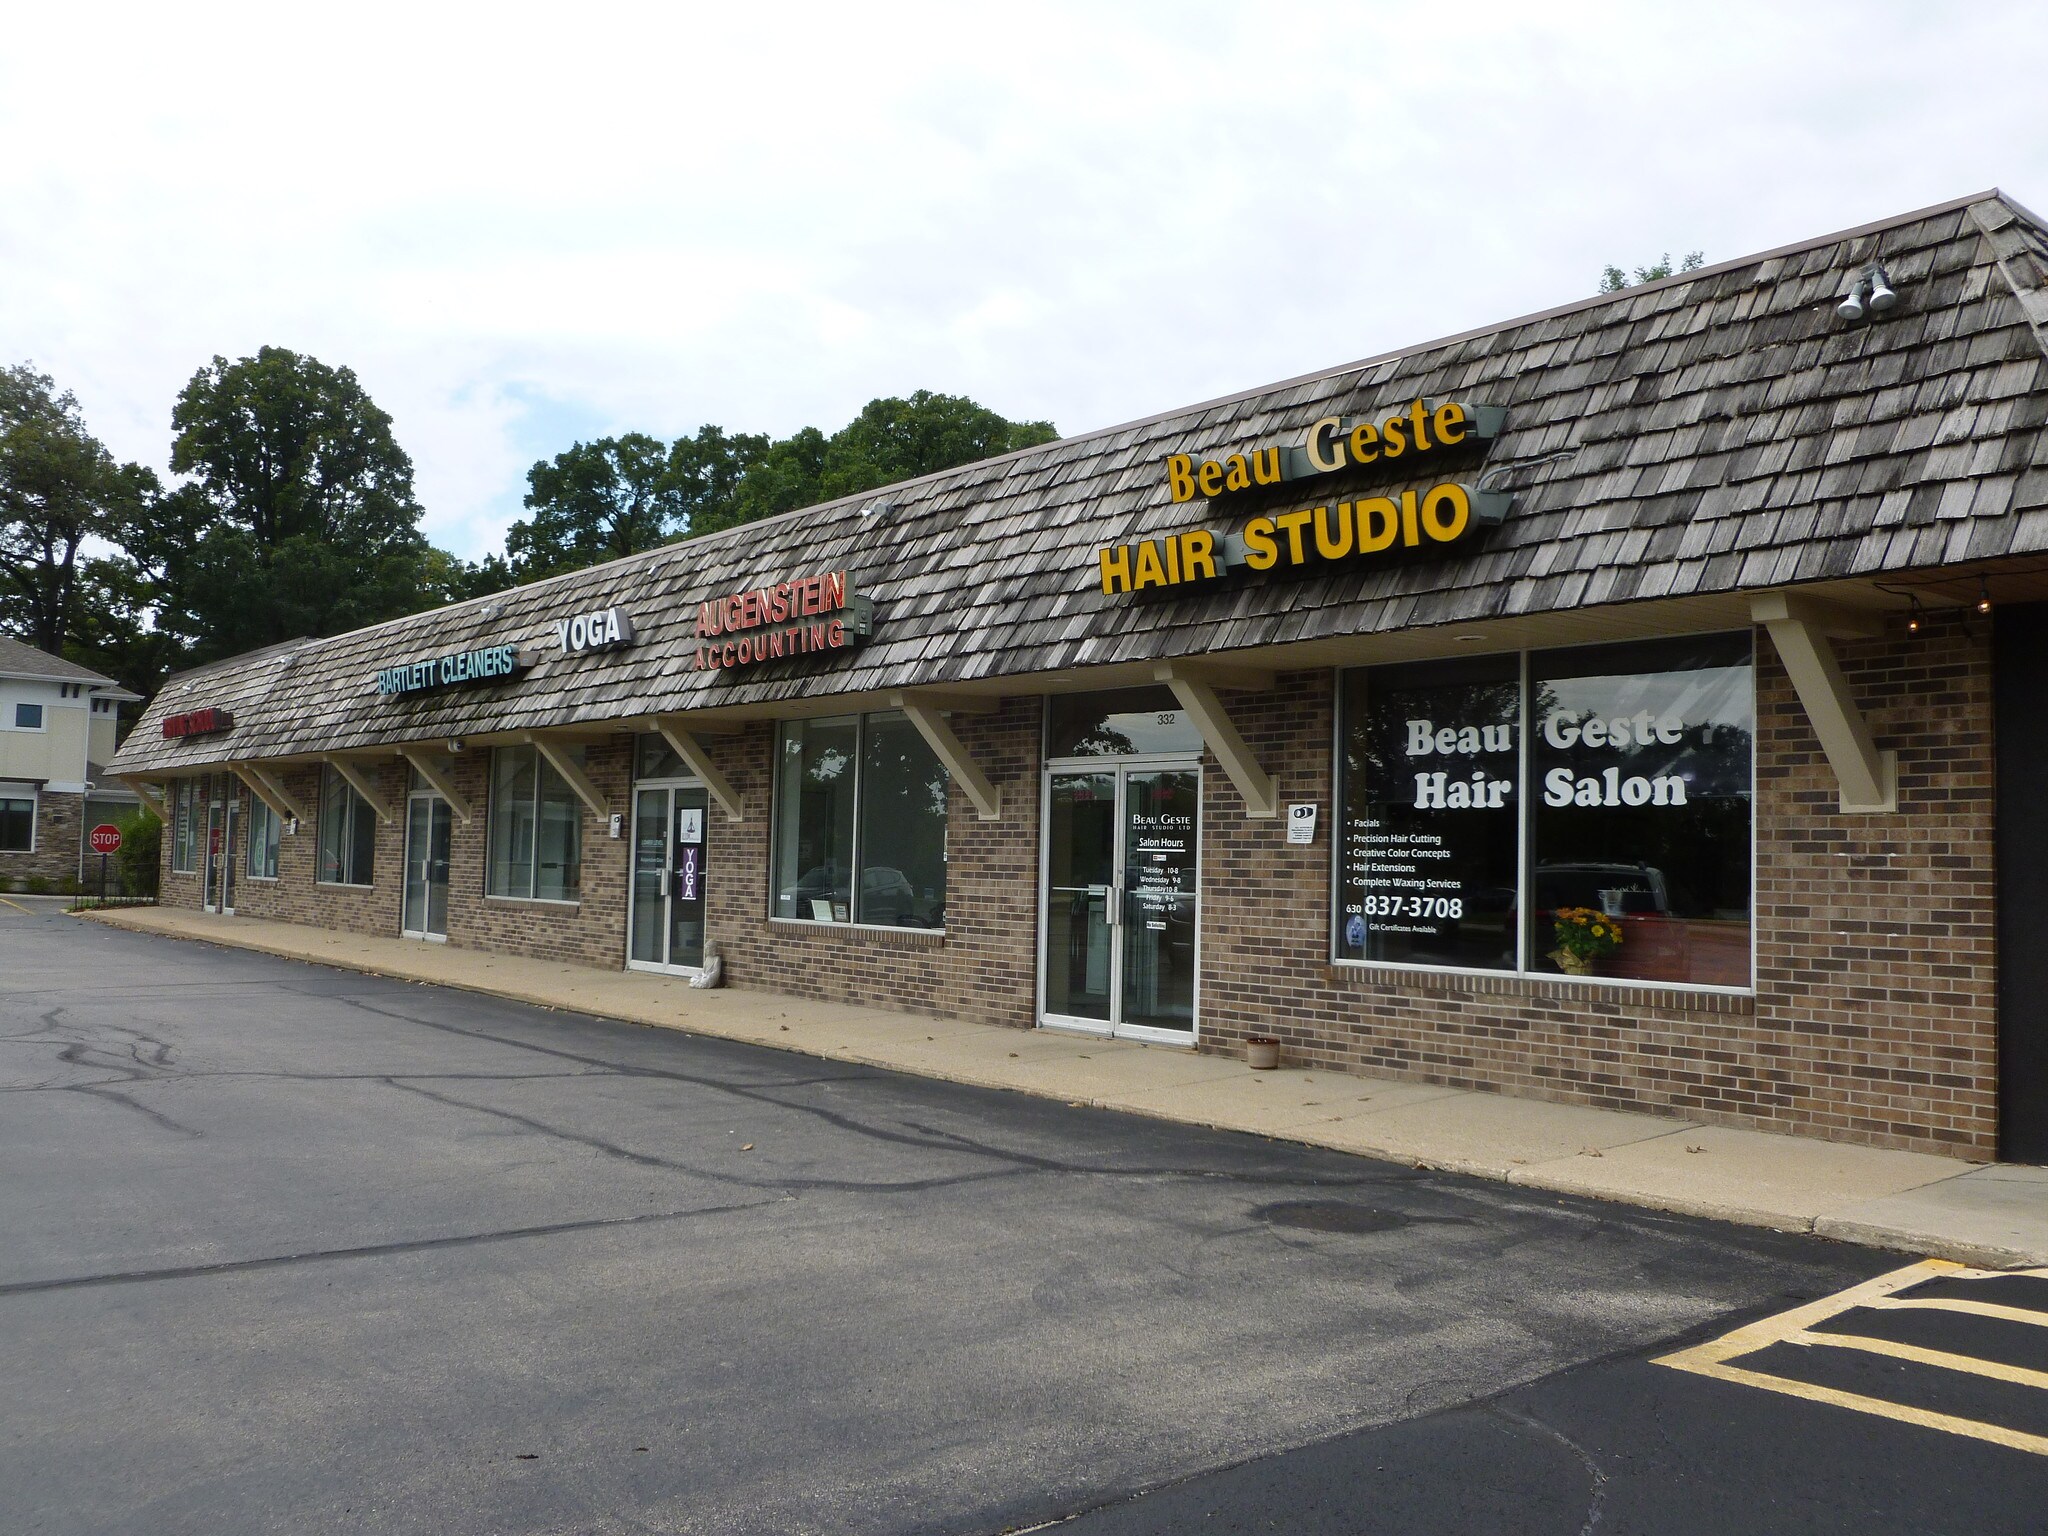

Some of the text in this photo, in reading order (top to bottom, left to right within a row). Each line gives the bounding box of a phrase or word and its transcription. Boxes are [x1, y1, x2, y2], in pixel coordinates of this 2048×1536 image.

[1167, 399, 1466, 503] Beau Geste
[1099, 483, 1471, 595] HAIR STUDIO
[695, 570, 846, 639] AUGENSTEIN
[556, 607, 620, 653] YOGA
[693, 619, 844, 672] ACCOUNTING
[378, 645, 513, 696] BARTLETT CLEANERS
[1157, 713, 1175, 726] 332
[1405, 709, 1683, 756] Beau Geste
[1413, 766, 1688, 809] Hair Salon
[1353, 819, 1380, 828] Facials
[92, 833, 120, 845] STOP
[1139, 837, 1184, 847] Salon Hours
[1353, 834, 1442, 846] Precision Hair Cutting
[1353, 849, 1451, 860] Creative Color Concepts
[684, 849, 695, 897] YOGA
[1142, 866, 1164, 875] Tuesday
[1352, 863, 1416, 873] Hair Extensions
[1140, 876, 1170, 885] Wednesday
[1352, 877, 1461, 890] Complete Waxing Services
[1142, 885, 1166, 893] Thursday
[1142, 902, 1166, 911] Saturday
[1345, 895, 1462, 919] 630 837-3708
[1368, 923, 1437, 934] Gift Certificates Available
